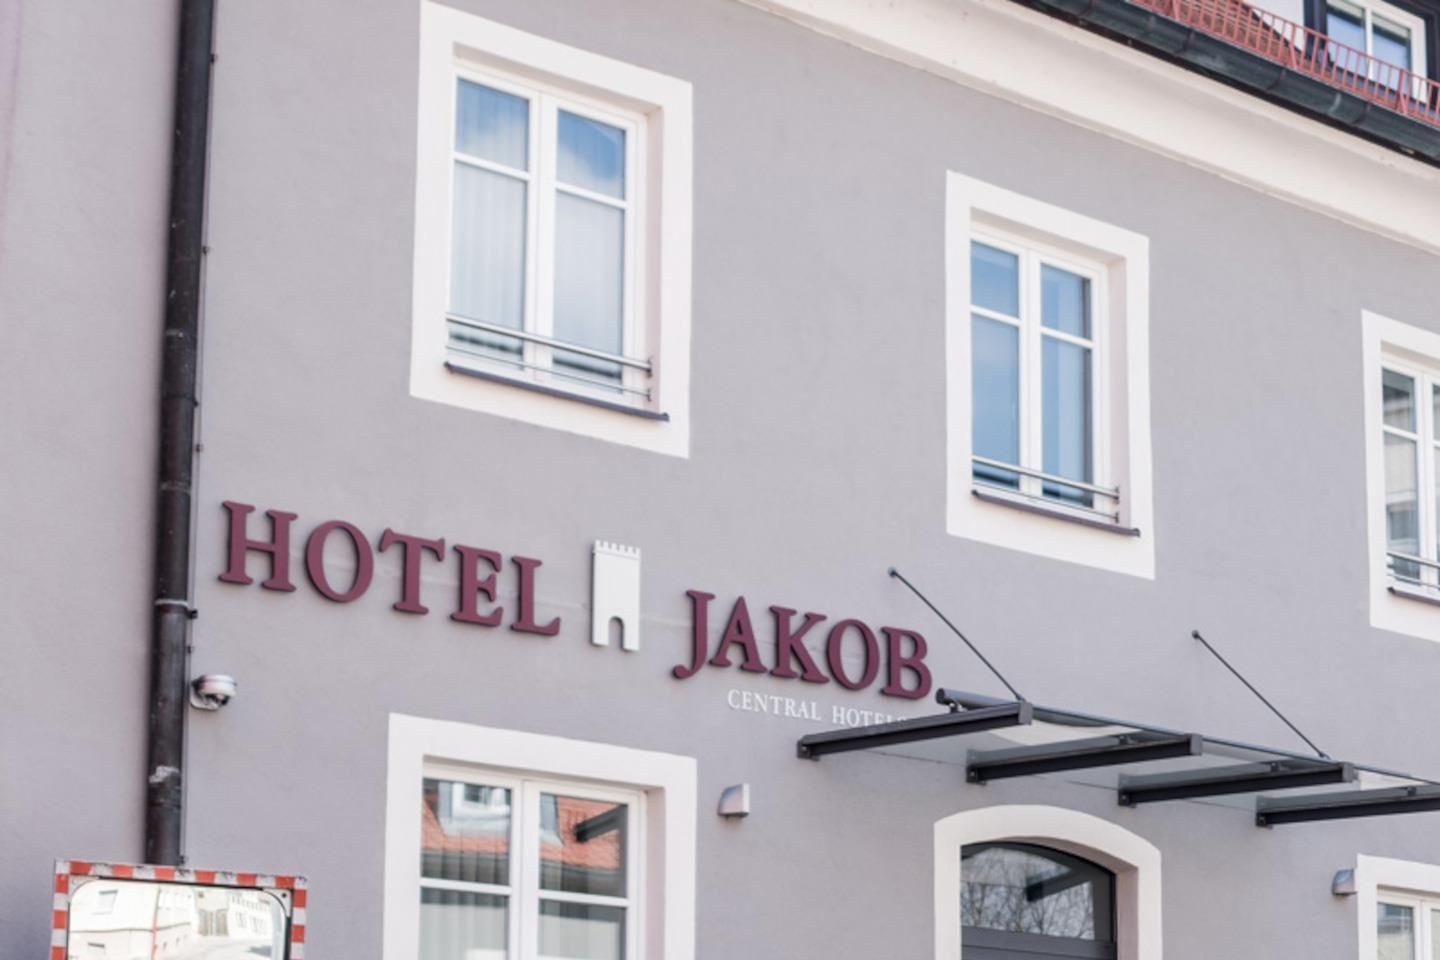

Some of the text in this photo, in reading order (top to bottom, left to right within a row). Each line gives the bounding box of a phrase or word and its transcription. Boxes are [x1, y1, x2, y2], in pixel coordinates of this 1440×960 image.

[218, 500, 932, 700] HOTEL JAKOB
[727, 688, 822, 721] CENTRAL
